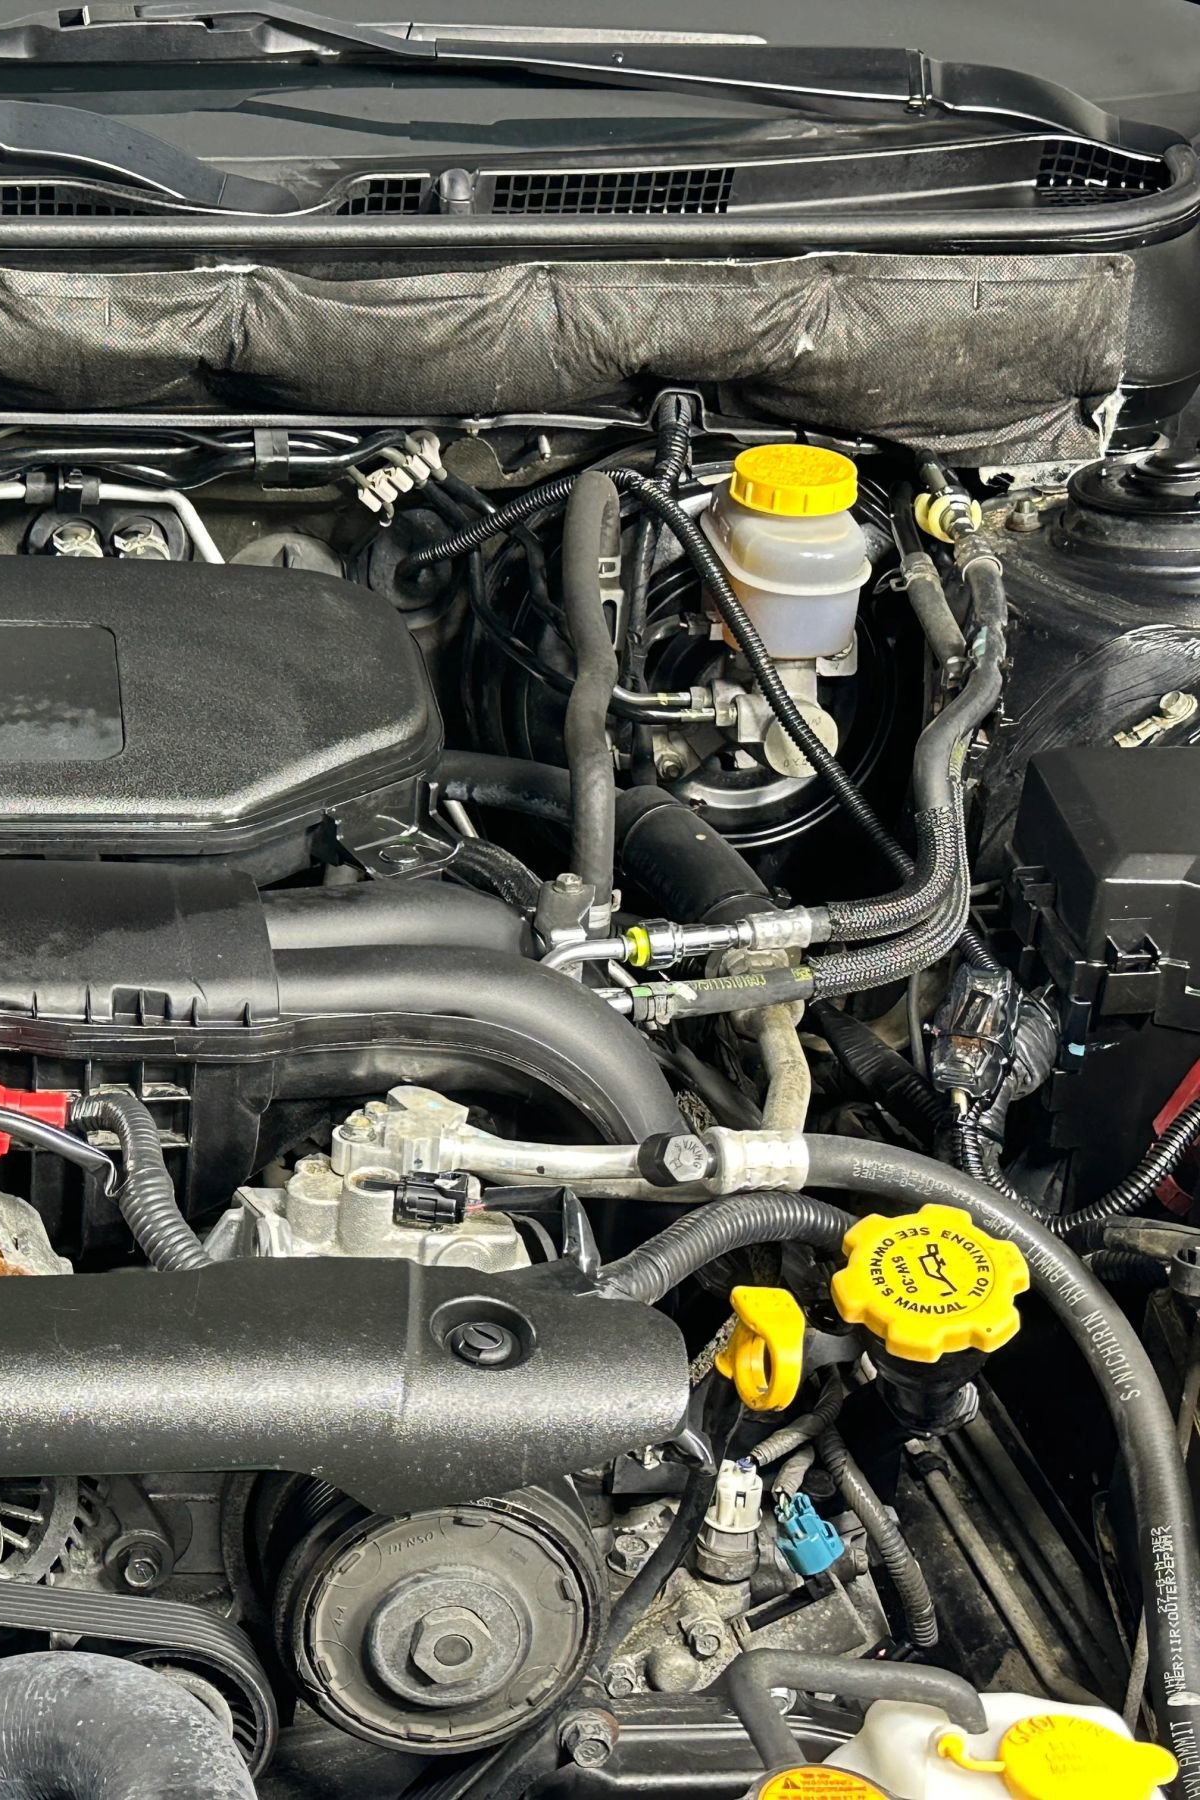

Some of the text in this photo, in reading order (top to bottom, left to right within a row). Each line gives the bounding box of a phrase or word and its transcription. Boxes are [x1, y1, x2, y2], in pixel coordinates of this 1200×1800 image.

[869, 1227, 968, 1314] SEE OWNER'S MANUAL
[940, 1229, 990, 1297] ENGINE OIL
